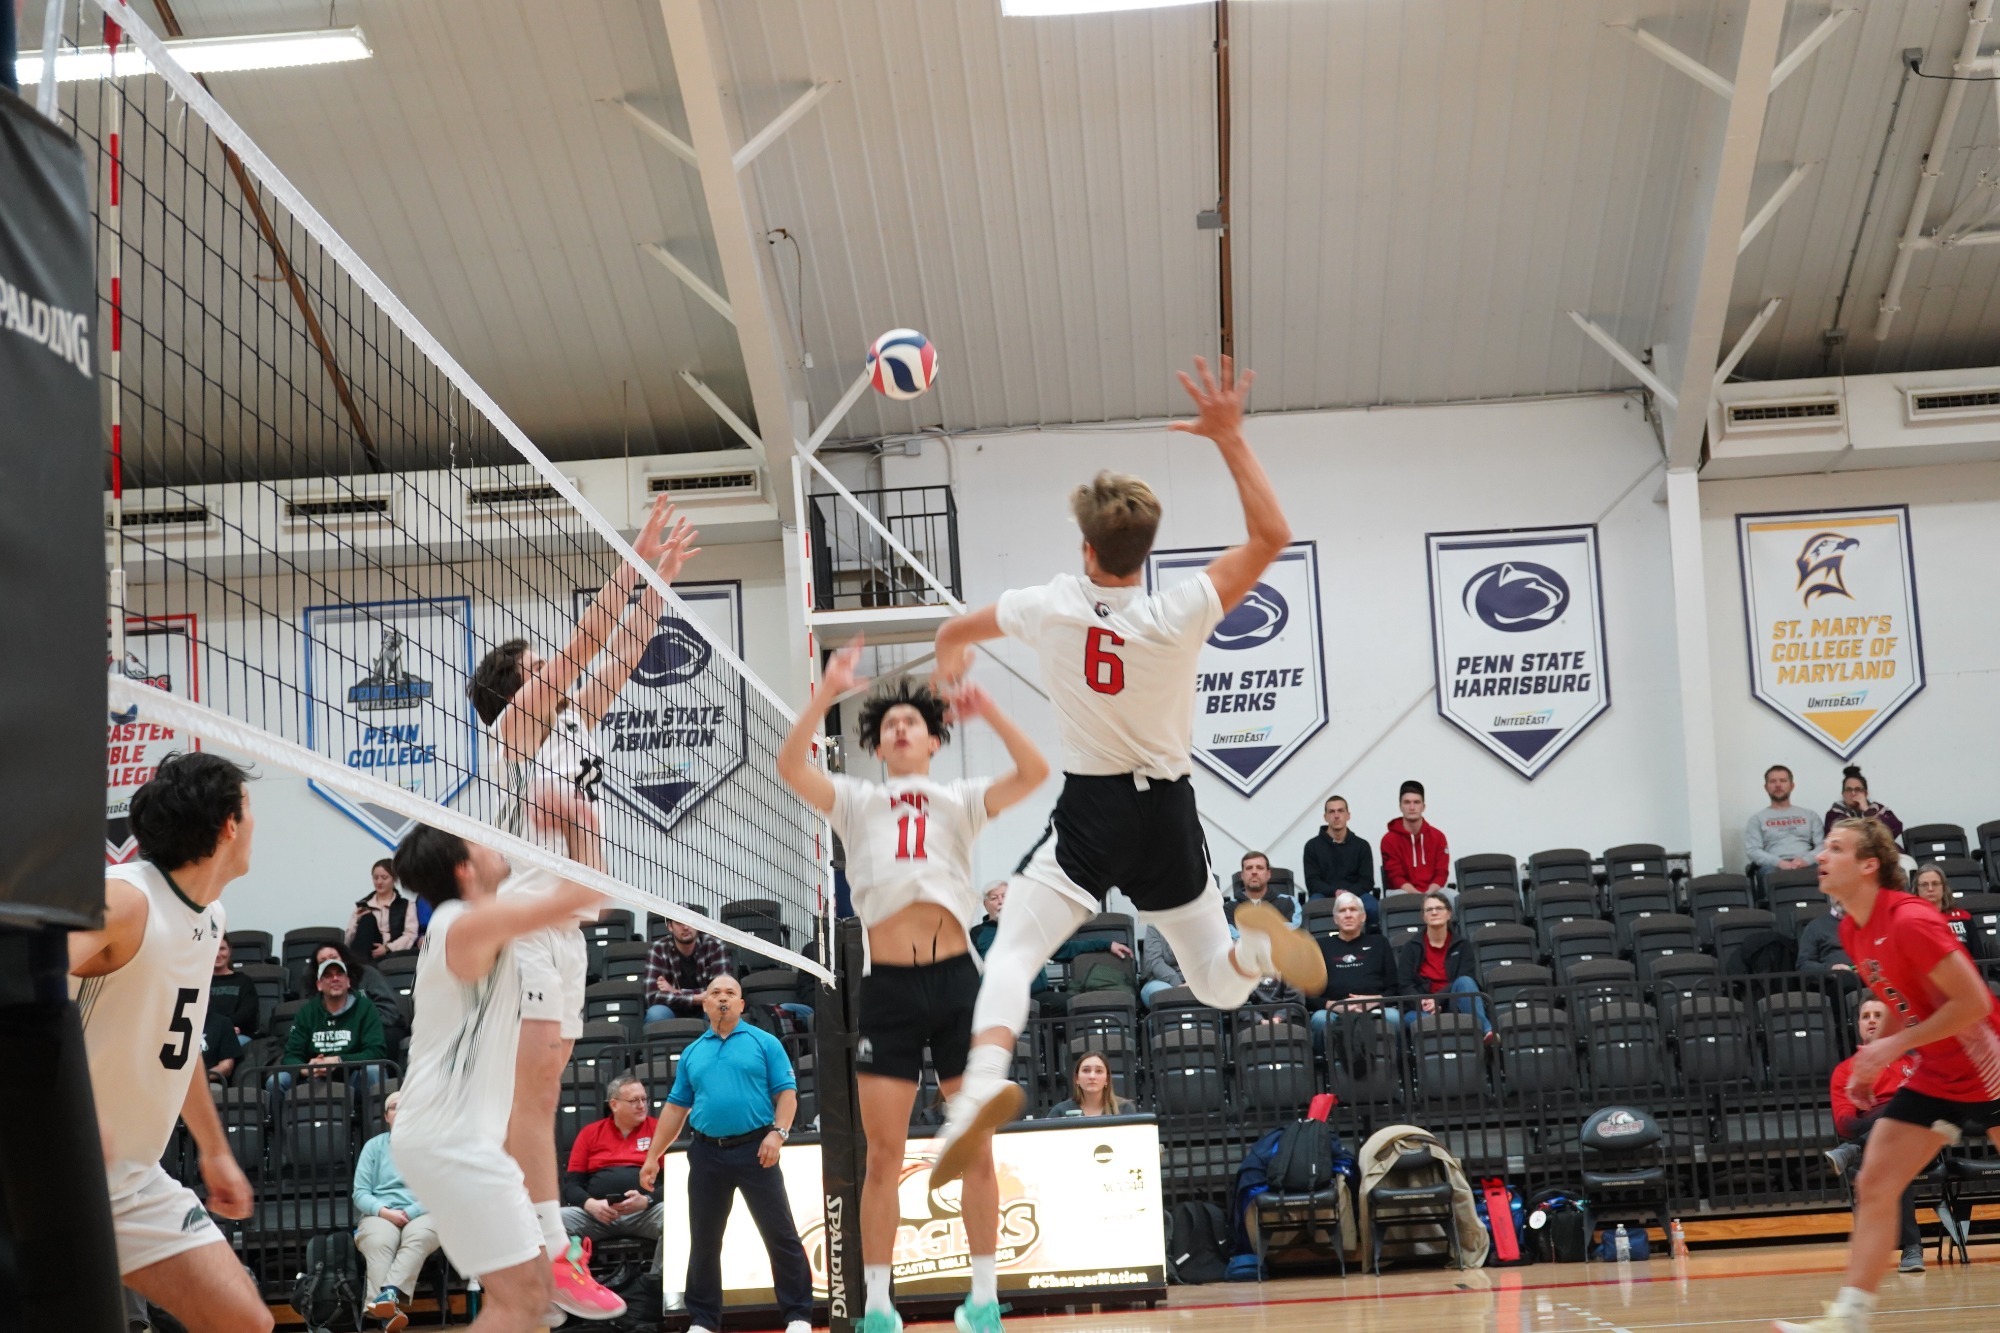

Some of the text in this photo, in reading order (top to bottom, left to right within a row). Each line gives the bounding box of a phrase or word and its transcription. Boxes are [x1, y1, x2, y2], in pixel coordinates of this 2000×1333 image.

[1772, 615, 1892, 640] ST. MARY'S
[1085, 626, 1125, 695] 6
[1771, 637, 1898, 662] COLLEGE OF
[1456, 651, 1586, 676] PENN STATE
[1777, 659, 1896, 685] MARYLAND
[1239, 667, 1304, 690] STATE
[1453, 673, 1591, 698] HARRISBURG
[1206, 692, 1277, 714] BERKS
[601, 706, 725, 731] PENN STATE
[106, 723, 175, 743] ASTER
[363, 724, 420, 746] PENN
[611, 729, 716, 752] ABINGTON
[347, 745, 437, 768] COLLEGE
[895, 813, 928, 861] 11
[159, 988, 199, 1070] 5
[826, 1194, 848, 1319] SPALDING
[1028, 1271, 1149, 1289] #ChargerNation
